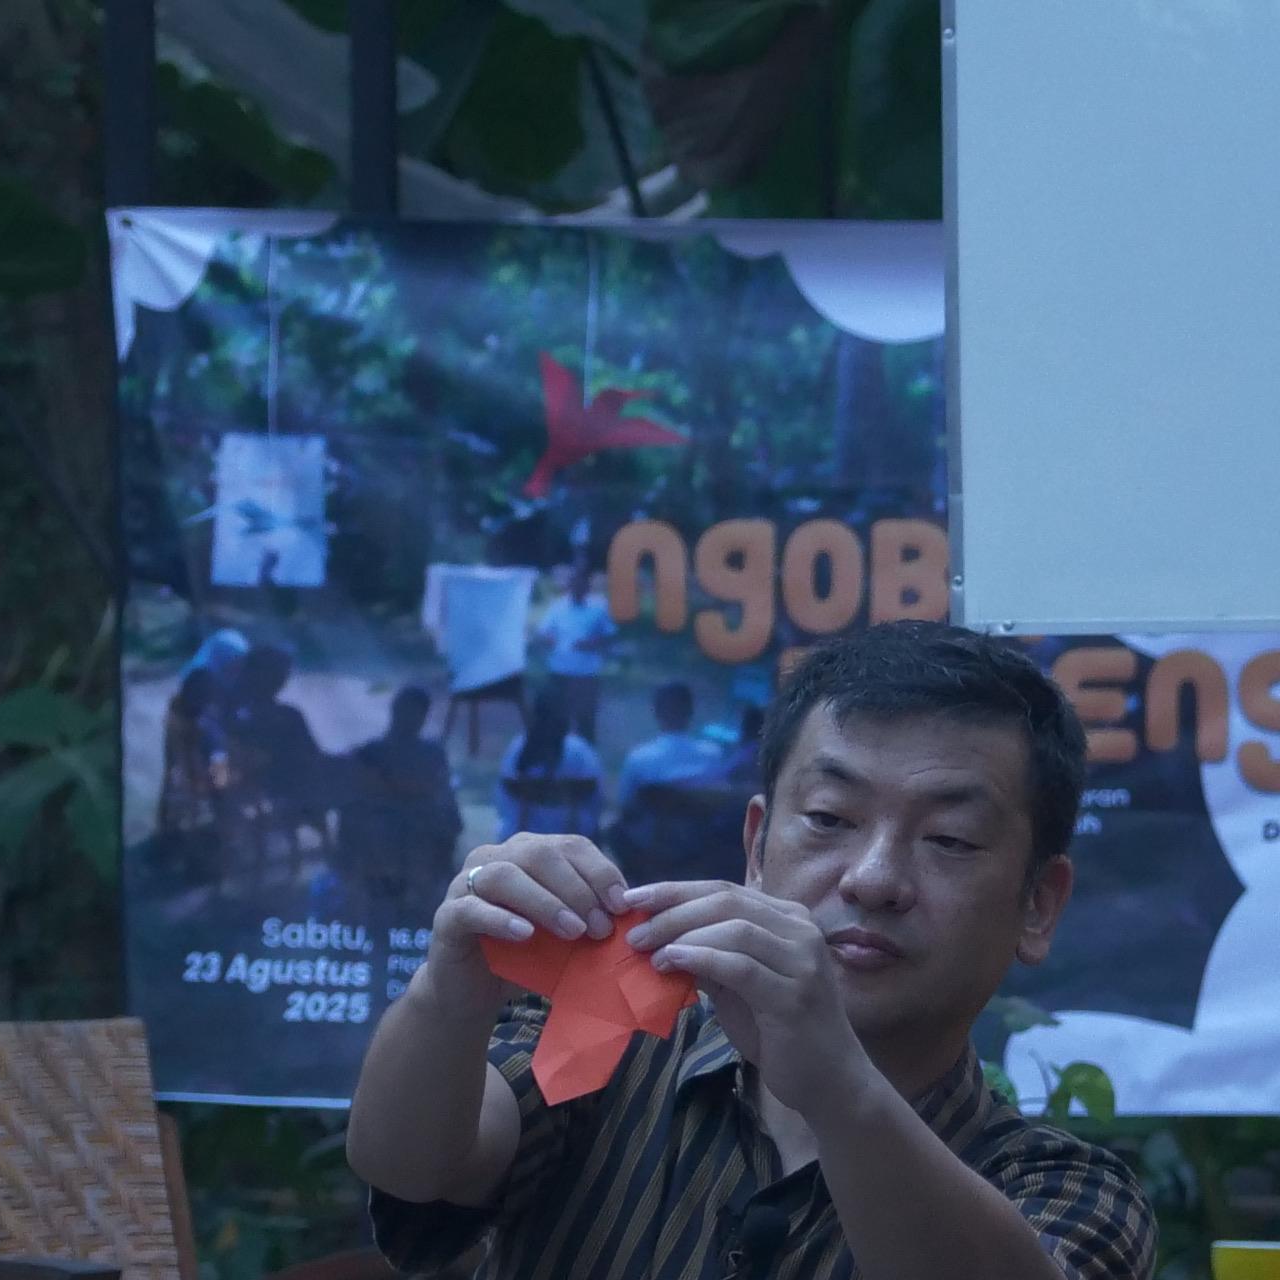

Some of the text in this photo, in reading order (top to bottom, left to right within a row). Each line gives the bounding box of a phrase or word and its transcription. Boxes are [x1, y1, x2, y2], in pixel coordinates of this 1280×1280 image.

[261, 916, 374, 955] Sabtu,
[182, 951, 223, 984] 23
[223, 952, 372, 994] Agustus
[283, 990, 372, 1025] 2025
